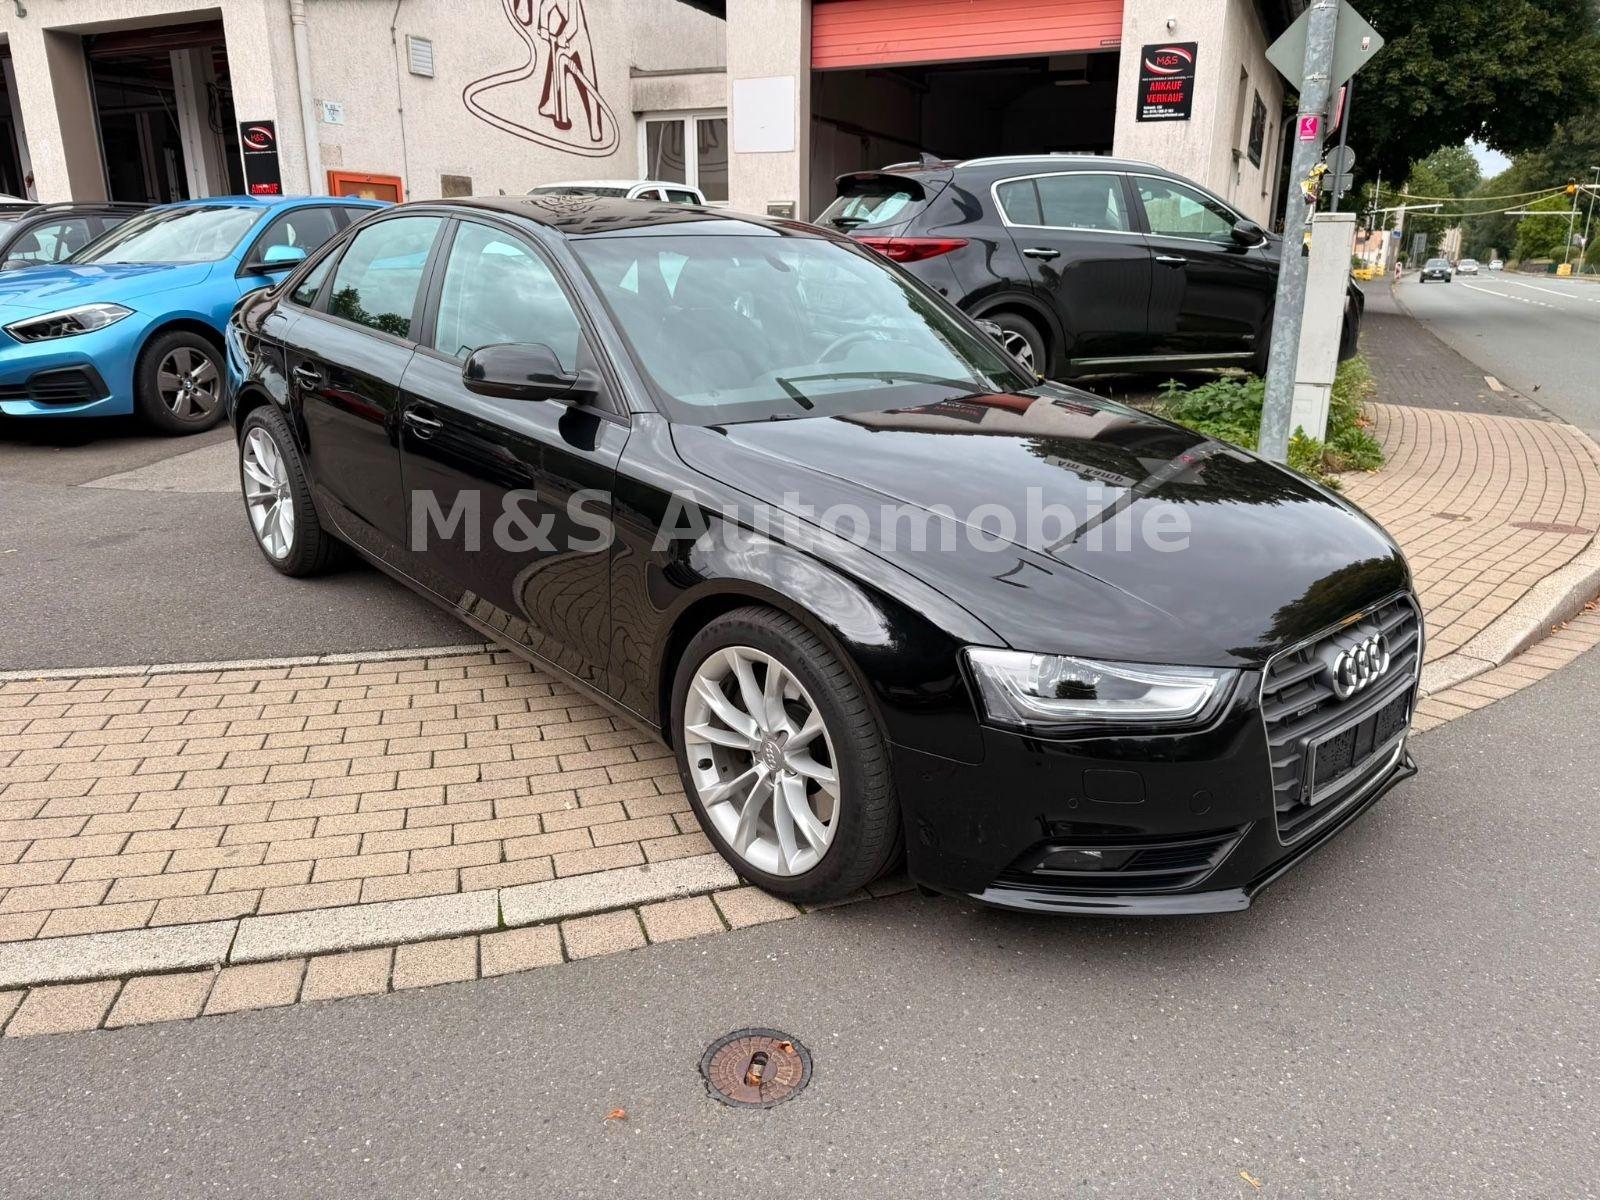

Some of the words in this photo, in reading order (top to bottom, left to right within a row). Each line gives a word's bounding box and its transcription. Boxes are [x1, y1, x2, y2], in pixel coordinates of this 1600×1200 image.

[1157, 56, 1178, 65] M&S
[1150, 81, 1183, 91] ANKAUF
[1147, 93, 1184, 103] VERKAUF
[252, 184, 278, 194] ANKAUF
